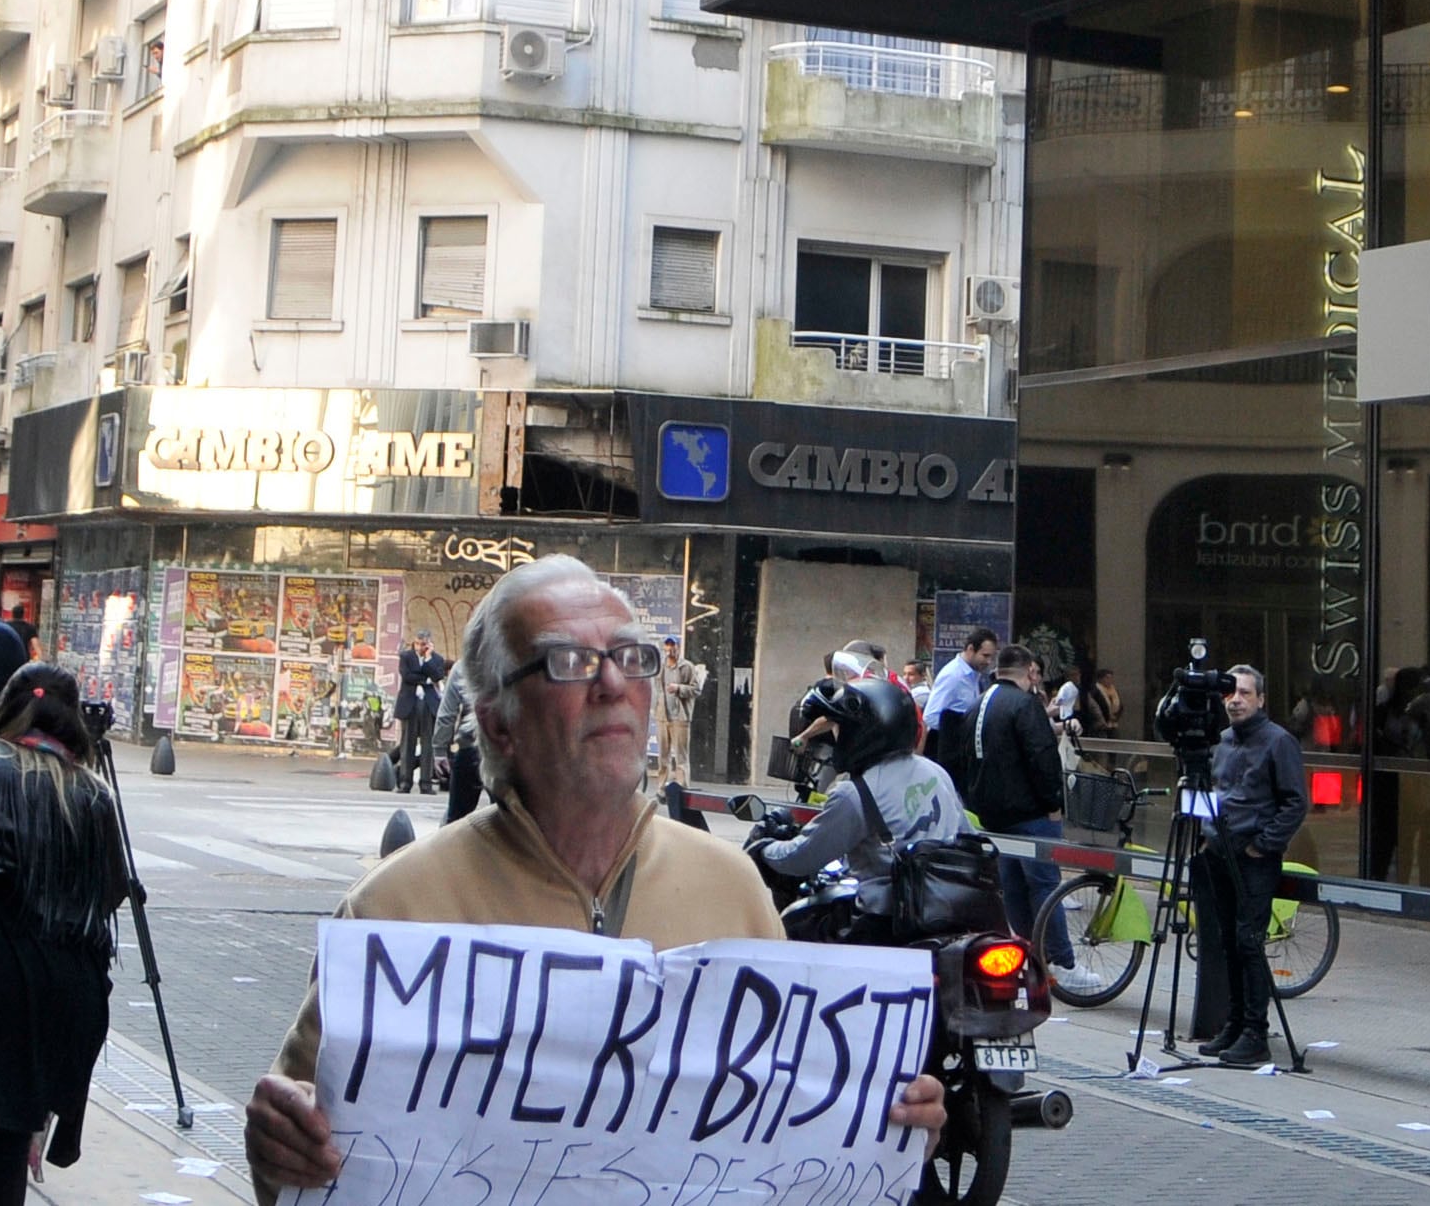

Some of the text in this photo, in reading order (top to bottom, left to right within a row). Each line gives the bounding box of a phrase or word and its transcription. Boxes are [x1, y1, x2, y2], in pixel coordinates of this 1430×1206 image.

[144, 429, 335, 474] CAMBIO
[748, 440, 1016, 502] CAMBIO A
[1311, 483, 1361, 678] SWISS
[690, 963, 933, 1152] BASTA
